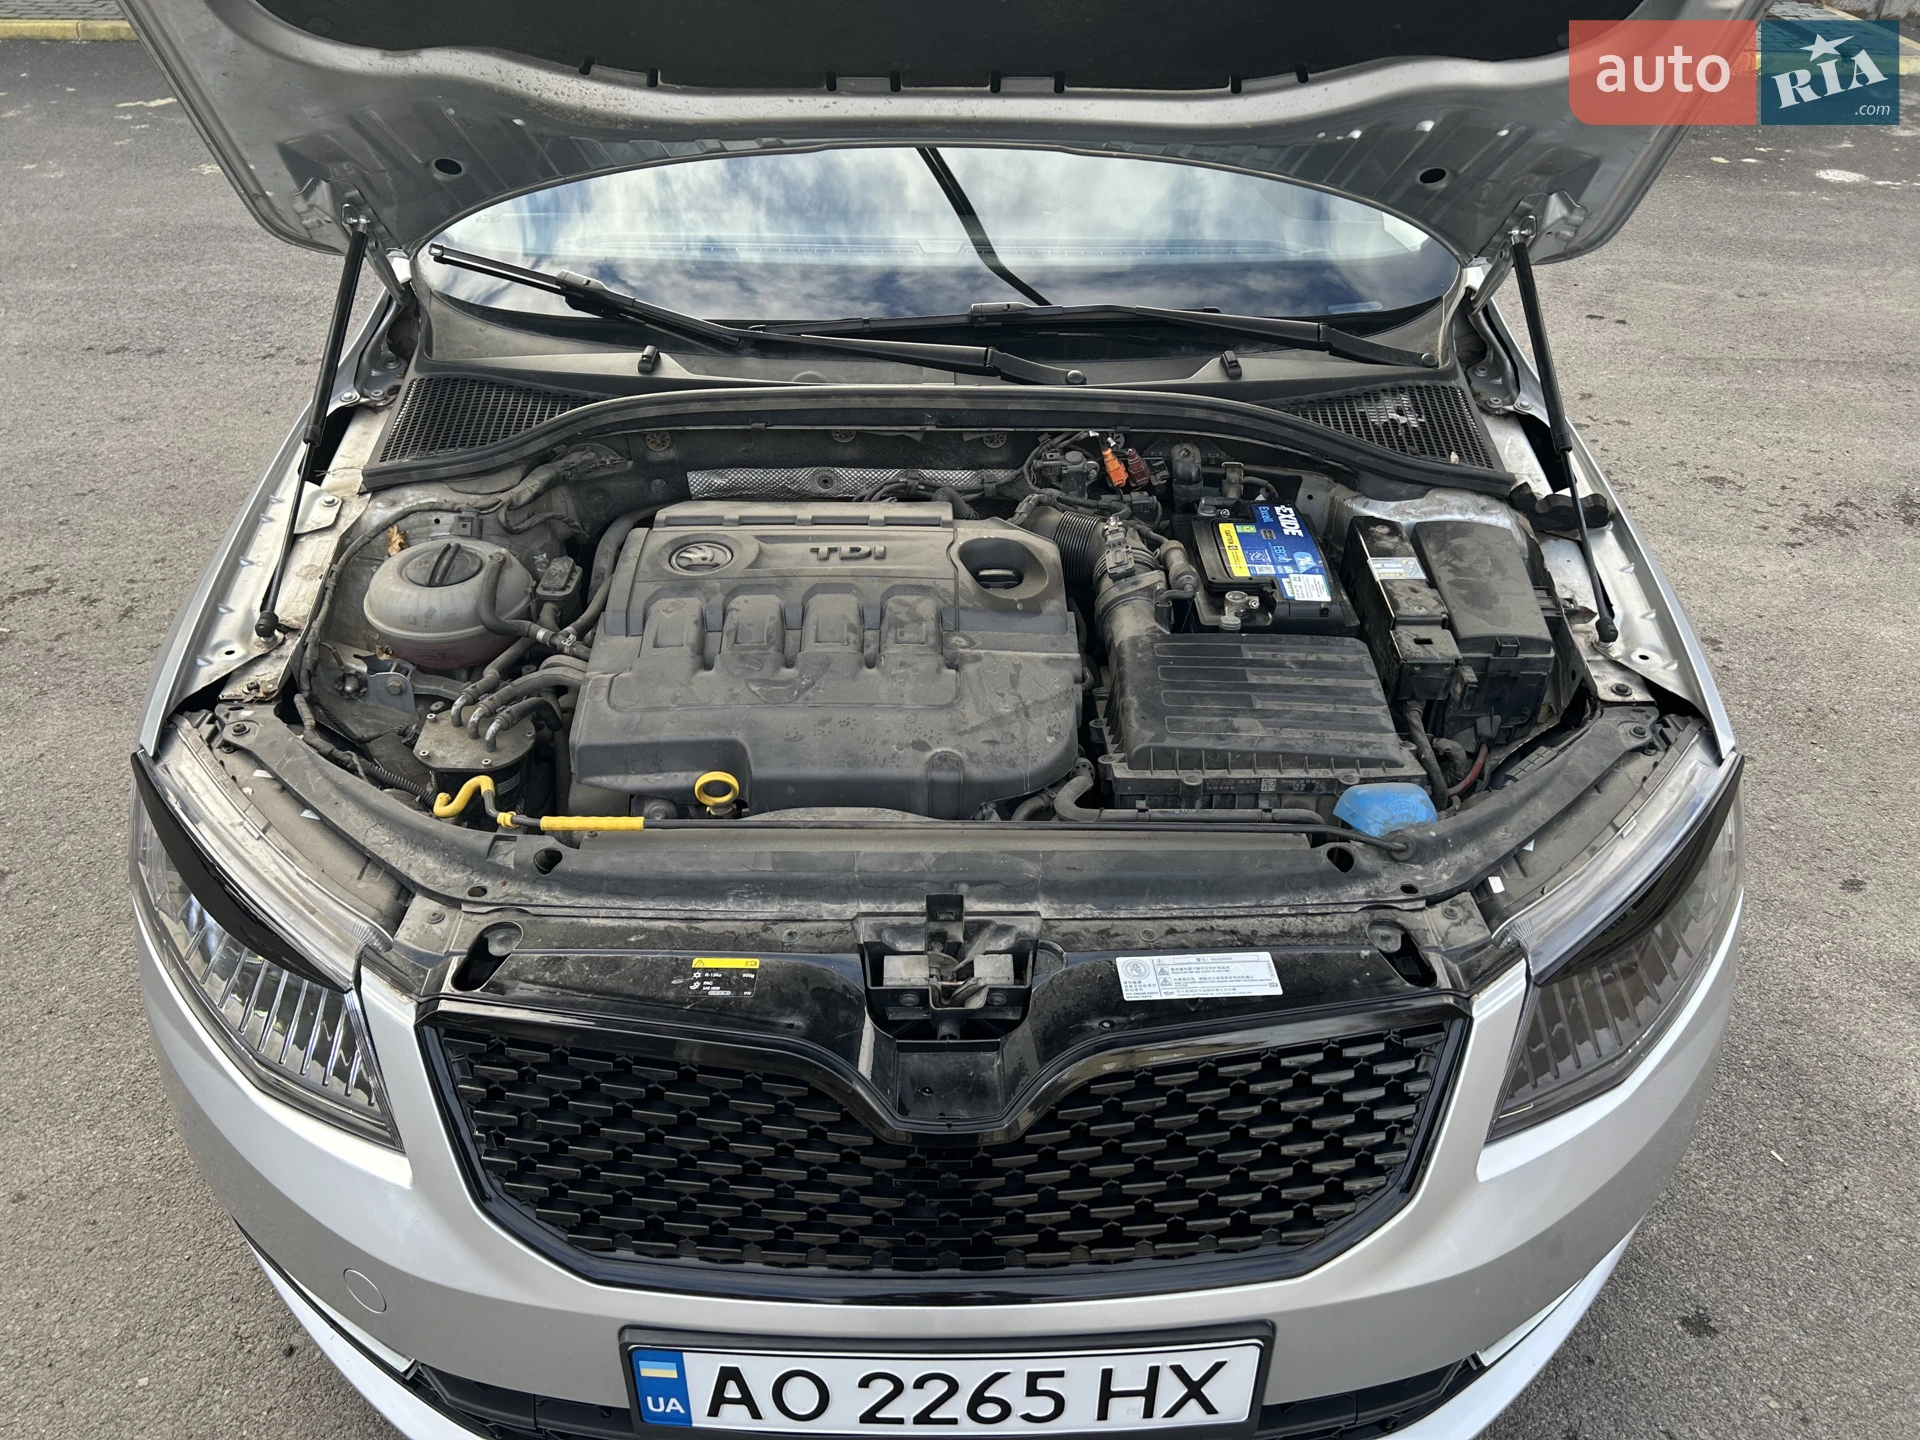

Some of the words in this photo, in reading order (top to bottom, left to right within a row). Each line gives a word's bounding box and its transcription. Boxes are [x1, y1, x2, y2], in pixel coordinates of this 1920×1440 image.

[1273, 504, 1304, 537] EXIDE
[809, 545, 887, 561] TDI
[646, 1396, 686, 1414] UA
[706, 1364, 831, 1422] AO
[857, 1368, 1066, 1426] 2265
[1095, 1359, 1229, 1422] HX
